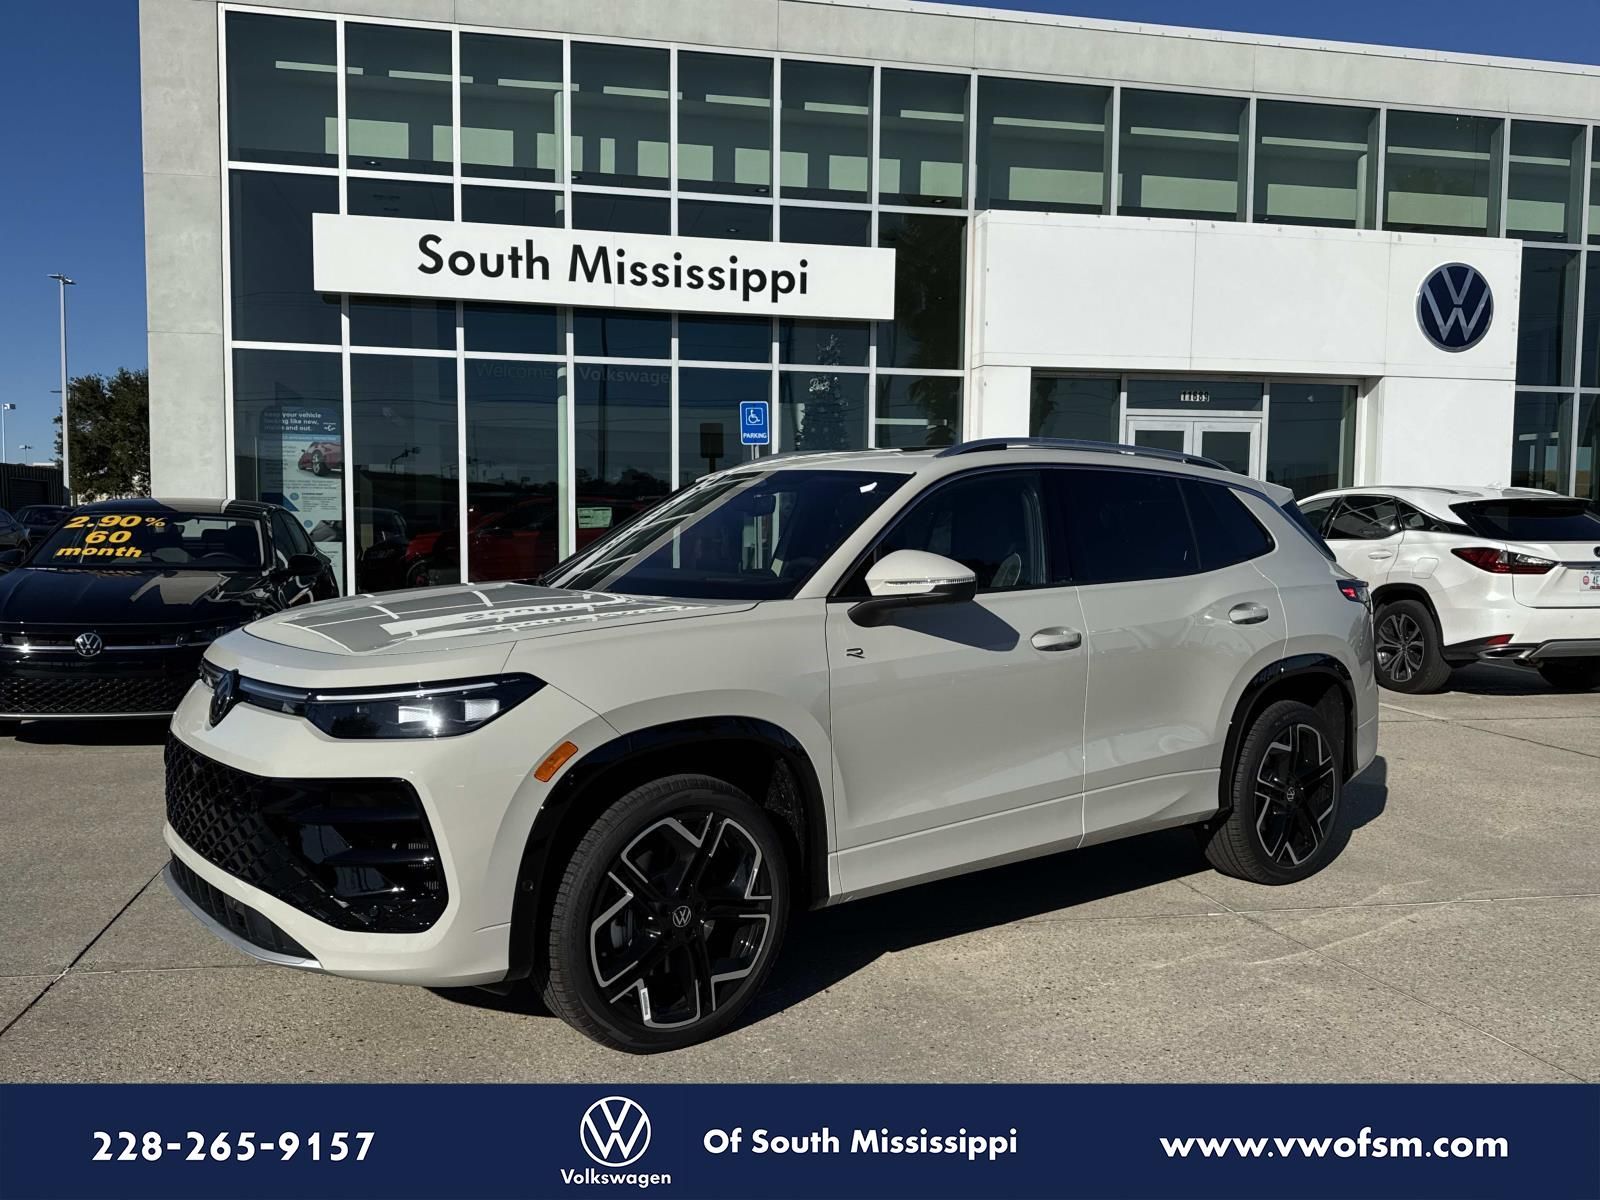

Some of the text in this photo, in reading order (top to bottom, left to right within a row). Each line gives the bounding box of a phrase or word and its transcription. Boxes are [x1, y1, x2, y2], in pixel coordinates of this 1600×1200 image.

[417, 233, 809, 304] South Mississippi
[578, 366, 673, 387] Volkswage
[282, 412, 298, 420] your
[298, 411, 322, 419] vehicle
[85, 530, 132, 544] 60
[56, 546, 143, 559] month
